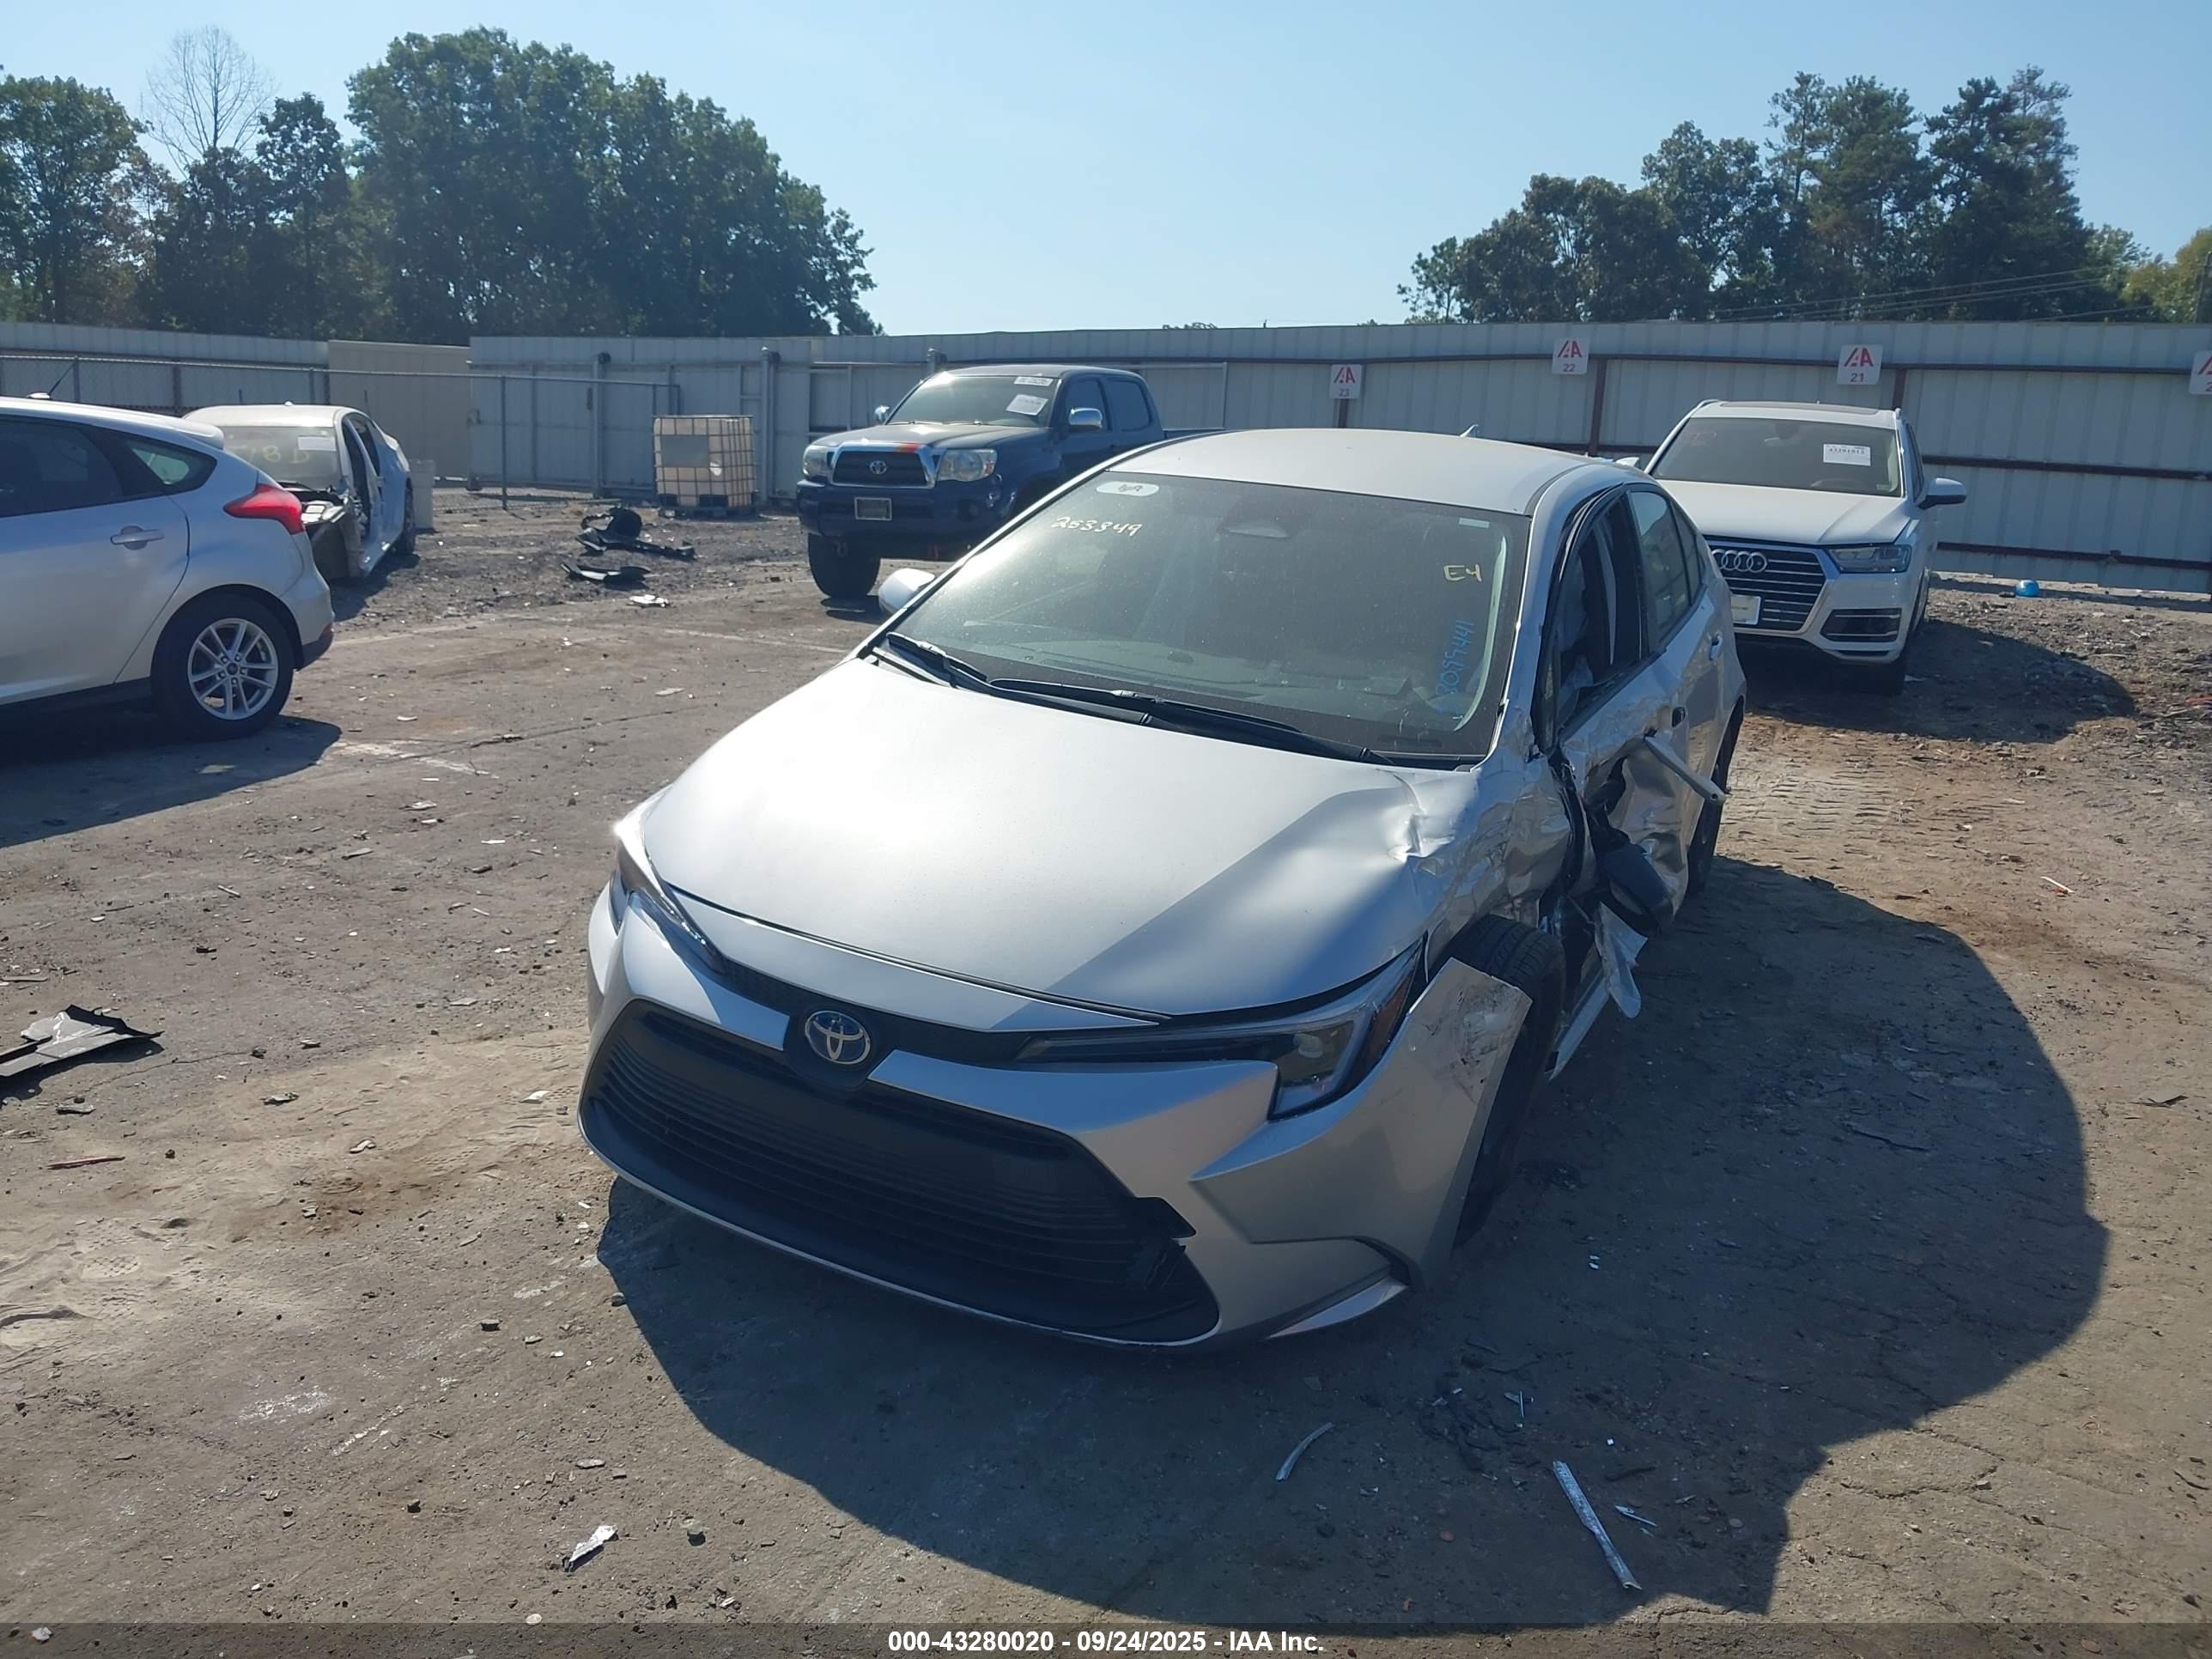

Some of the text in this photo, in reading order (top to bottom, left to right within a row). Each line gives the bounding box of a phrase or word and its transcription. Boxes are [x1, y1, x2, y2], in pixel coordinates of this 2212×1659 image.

[1563, 363, 1576, 373] 22
[1850, 373, 1864, 383] 21
[1443, 563, 1483, 582] E4
